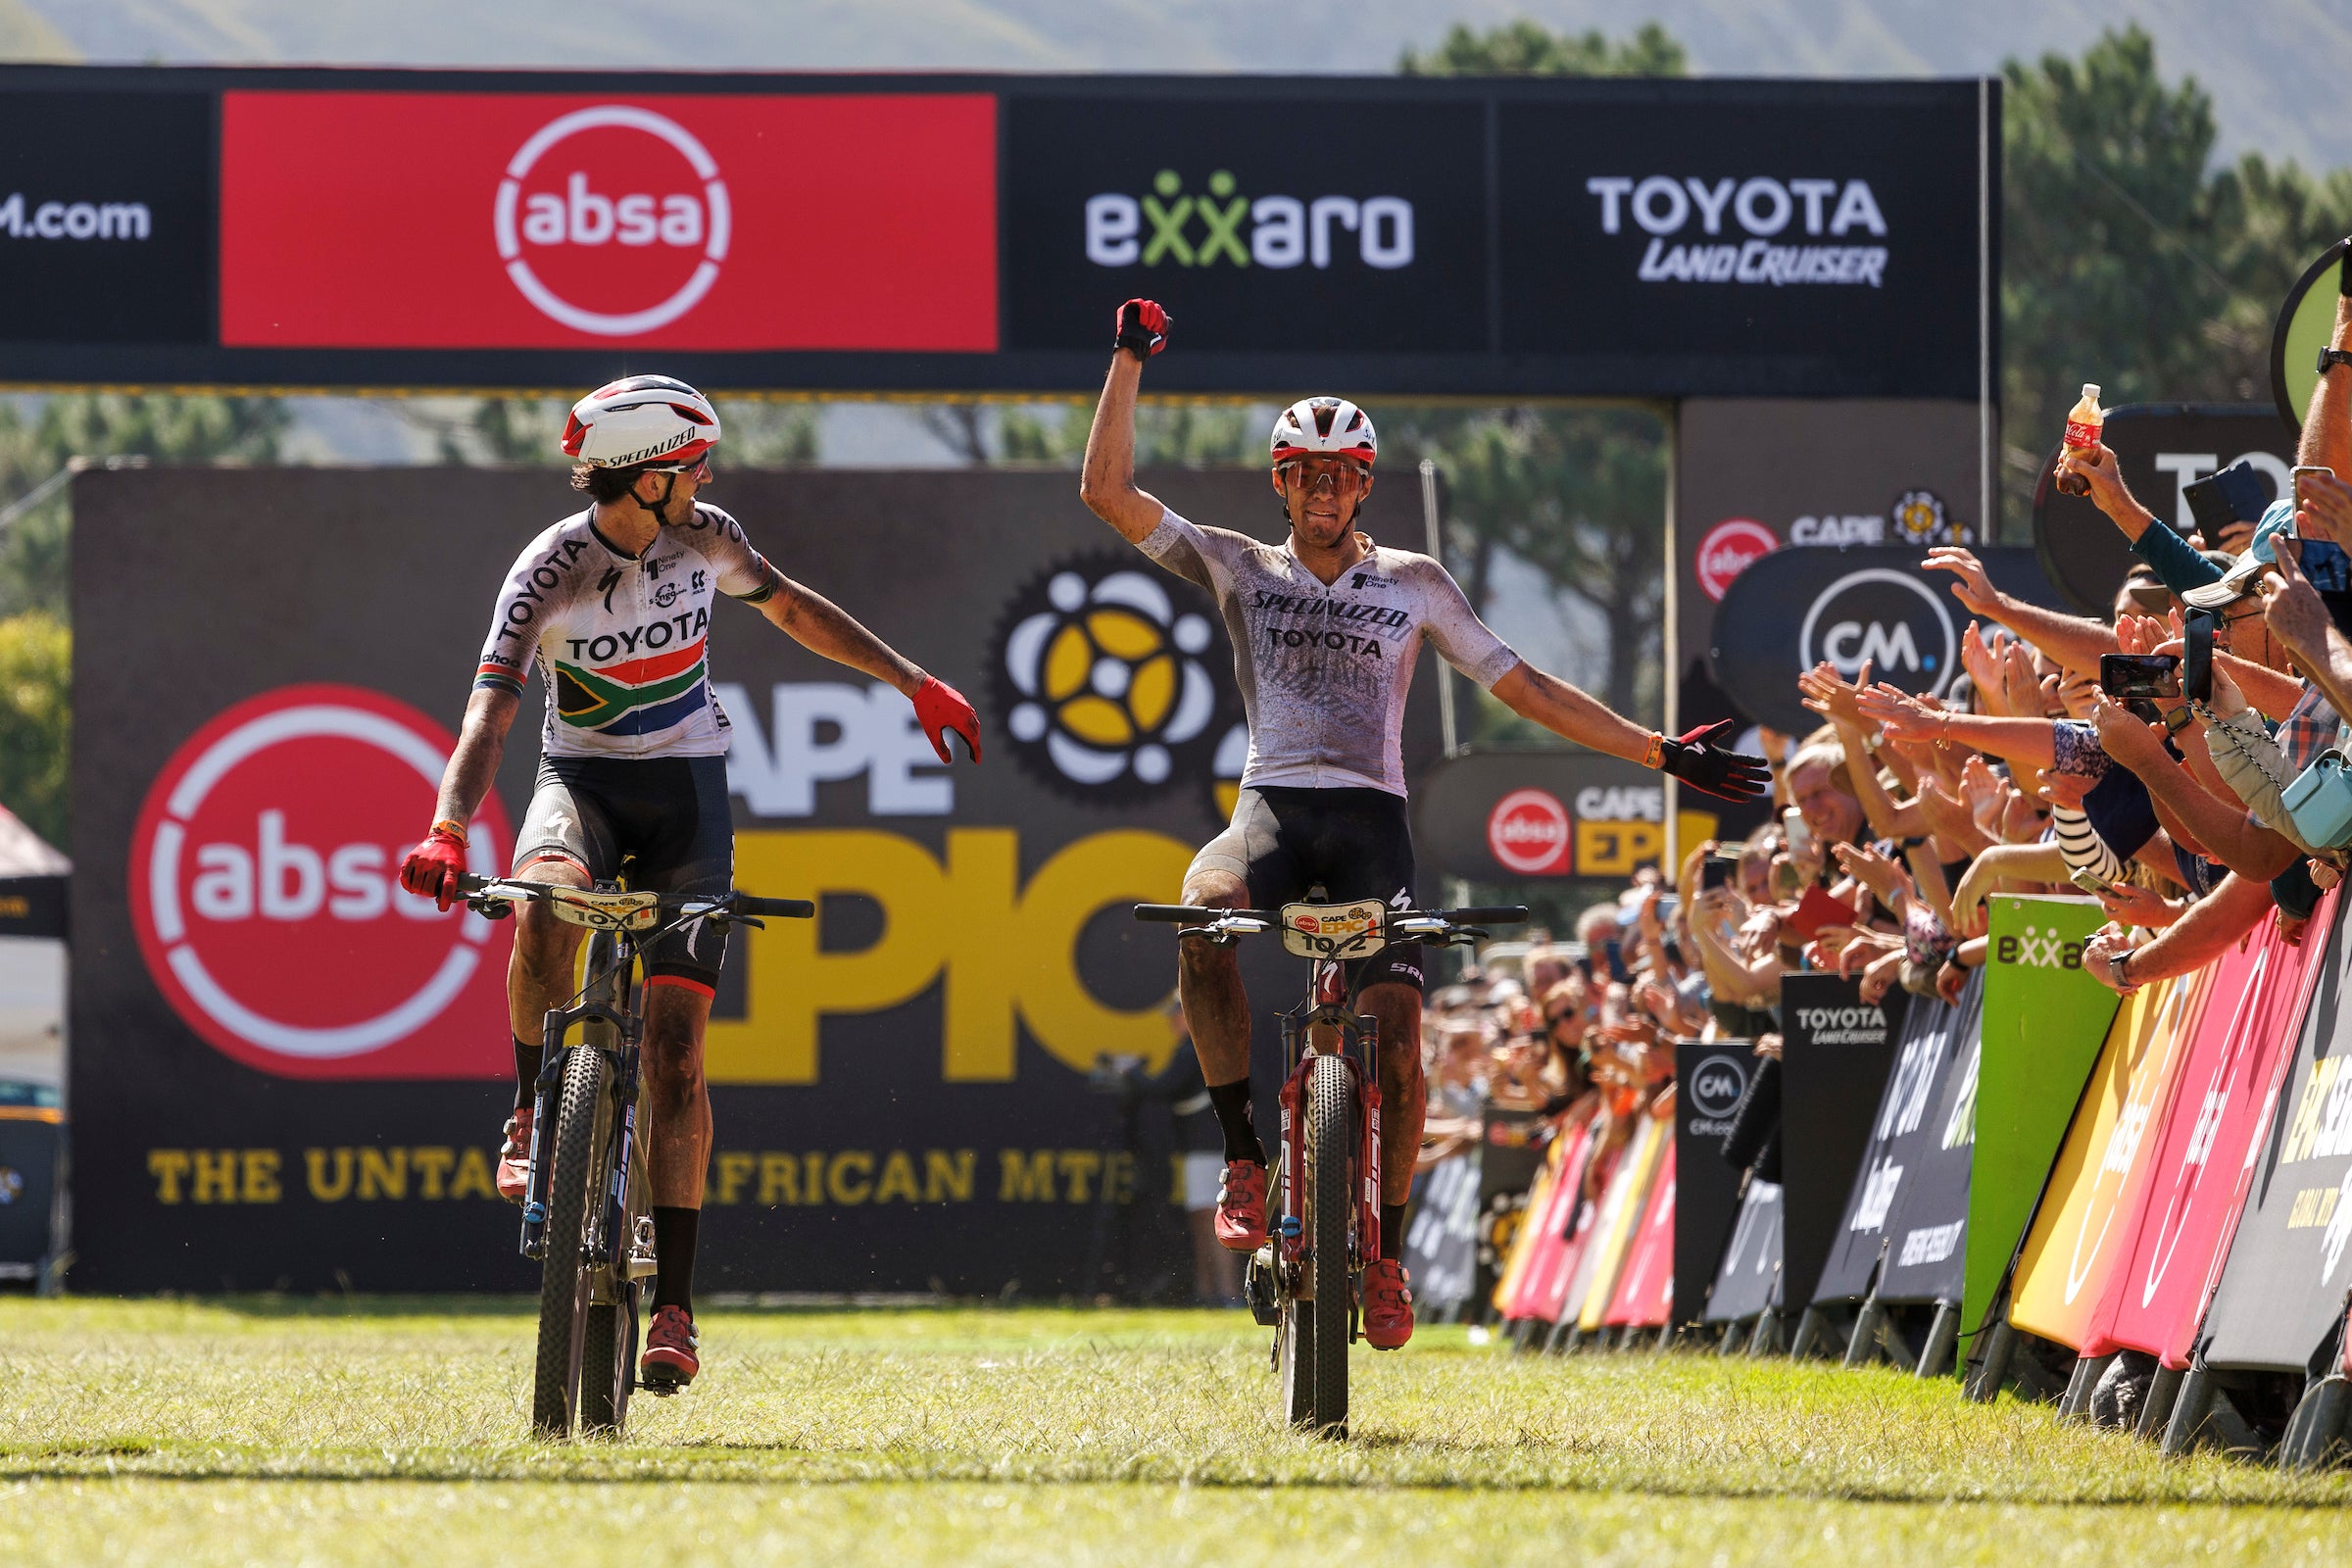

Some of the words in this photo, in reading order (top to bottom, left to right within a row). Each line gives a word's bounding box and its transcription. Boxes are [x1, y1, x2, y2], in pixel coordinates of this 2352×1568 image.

[522, 172, 704, 247] absa
[1084, 169, 1415, 270] exxaro
[1586, 174, 1888, 237] TOYOTA
[610, 425, 696, 467] SPECIALIZED
[658, 550, 685, 564] Ninety
[658, 562, 677, 572] One
[497, 538, 589, 642] TOYOTA
[1365, 580, 1387, 589] One
[1367, 574, 1399, 586] Ninety
[1250, 589, 1409, 628] SPECIALIZED
[565, 607, 708, 662] TOYOTA
[1266, 627, 1383, 660] TOYOTA
[480, 650, 521, 668] ahoo
[1575, 786, 1664, 822] CAPE
[1300, 935, 1366, 953] 102
[1320, 919, 1365, 934] EPIC
[708, 827, 1196, 1086] PIC
[1795, 1006, 1887, 1030] TOYOTA
[147, 1148, 282, 1203] THE
[702, 1148, 978, 1205] FRICAN
